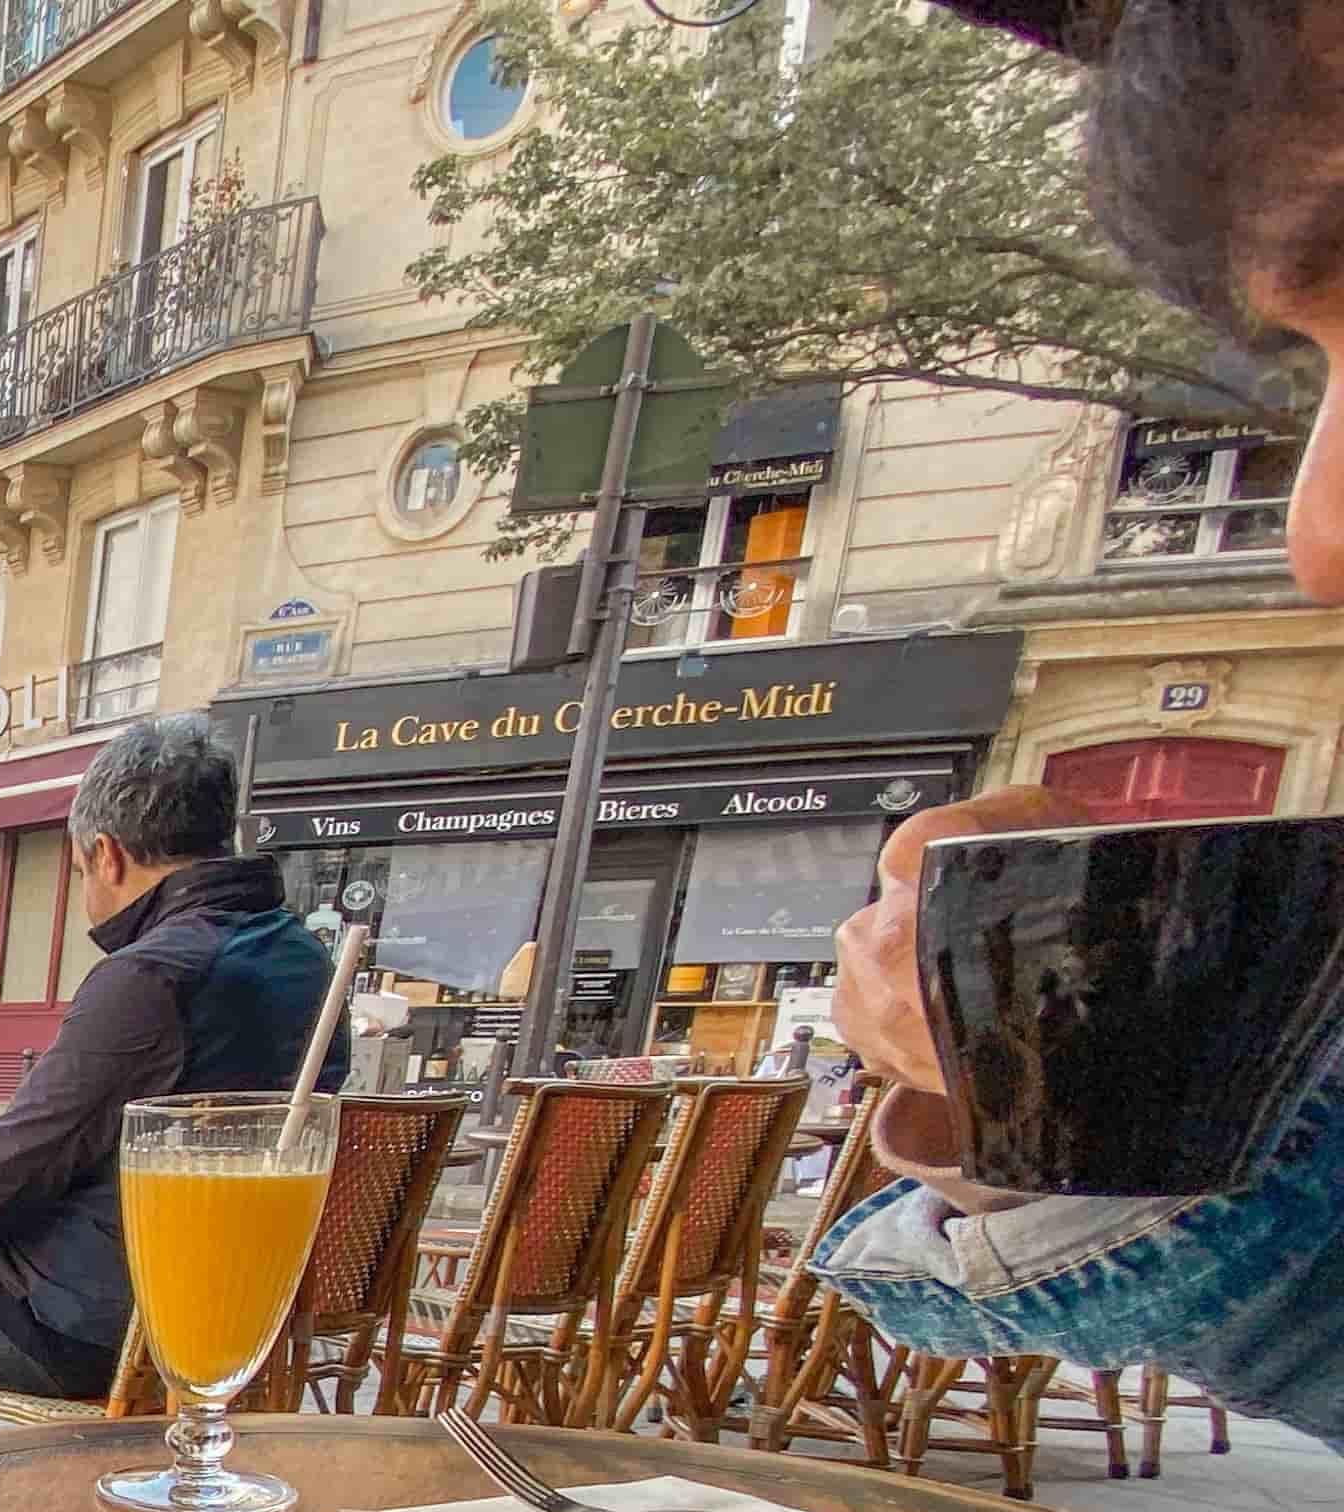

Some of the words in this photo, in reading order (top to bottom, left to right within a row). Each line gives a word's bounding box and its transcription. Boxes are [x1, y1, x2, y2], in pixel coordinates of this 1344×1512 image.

[334, 720, 379, 753] La
[392, 714, 479, 747] Cave
[491, 707, 539, 739] du
[554, 681, 838, 735] Cerche-Midi
[1168, 685, 1203, 708] 29
[311, 816, 361, 837] Vins
[398, 805, 555, 836] Champagnes
[597, 801, 679, 823] Bieres
[721, 790, 827, 817] Alcools
